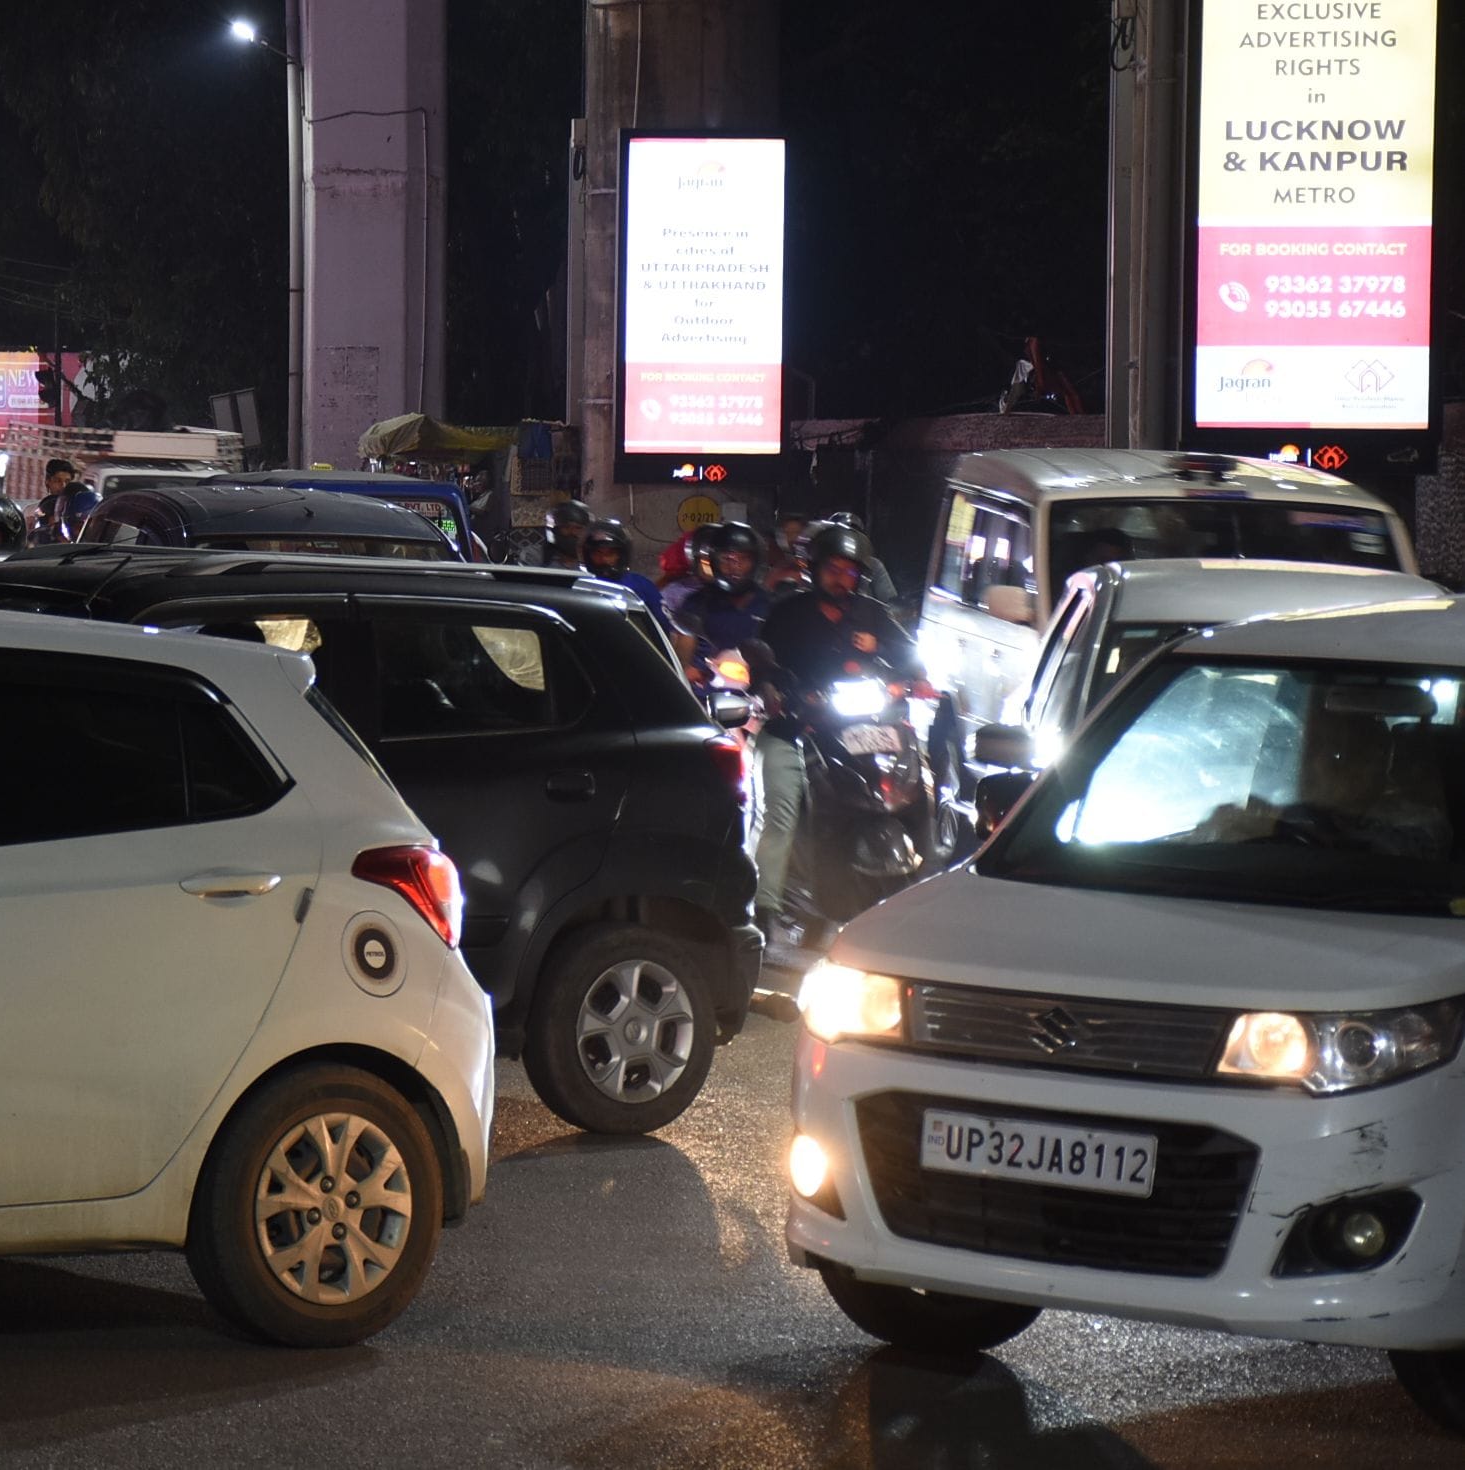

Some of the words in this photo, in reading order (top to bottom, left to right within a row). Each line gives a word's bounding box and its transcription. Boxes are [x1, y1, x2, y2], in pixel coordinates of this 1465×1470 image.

[1257, 3, 1382, 20] EXCLUSIVE
[1239, 30, 1397, 48] ADVERTISING
[1275, 59, 1361, 76] RIGHTS
[1308, 88, 1325, 104] in
[1225, 120, 1406, 141] LUCKNOW
[1223, 151, 1247, 172] &
[1259, 151, 1408, 172] KANPUR
[1273, 187, 1356, 204] METRO
[1219, 243, 1252, 256] FOR
[1256, 243, 1329, 256] BOOKING
[1333, 243, 1407, 256] CONTACT
[640, 263, 691, 273] UTTAR
[695, 263, 770, 273] PRADESH
[1265, 275, 1333, 294] 93362
[1338, 275, 1406, 294] 37978
[1265, 300, 1332, 319] 93055
[1338, 300, 1406, 319] 67446
[1218, 376, 1272, 392] Jagran
[928, 1134, 946, 1146] IND
[945, 1125, 1148, 1184] UP32JA8112
